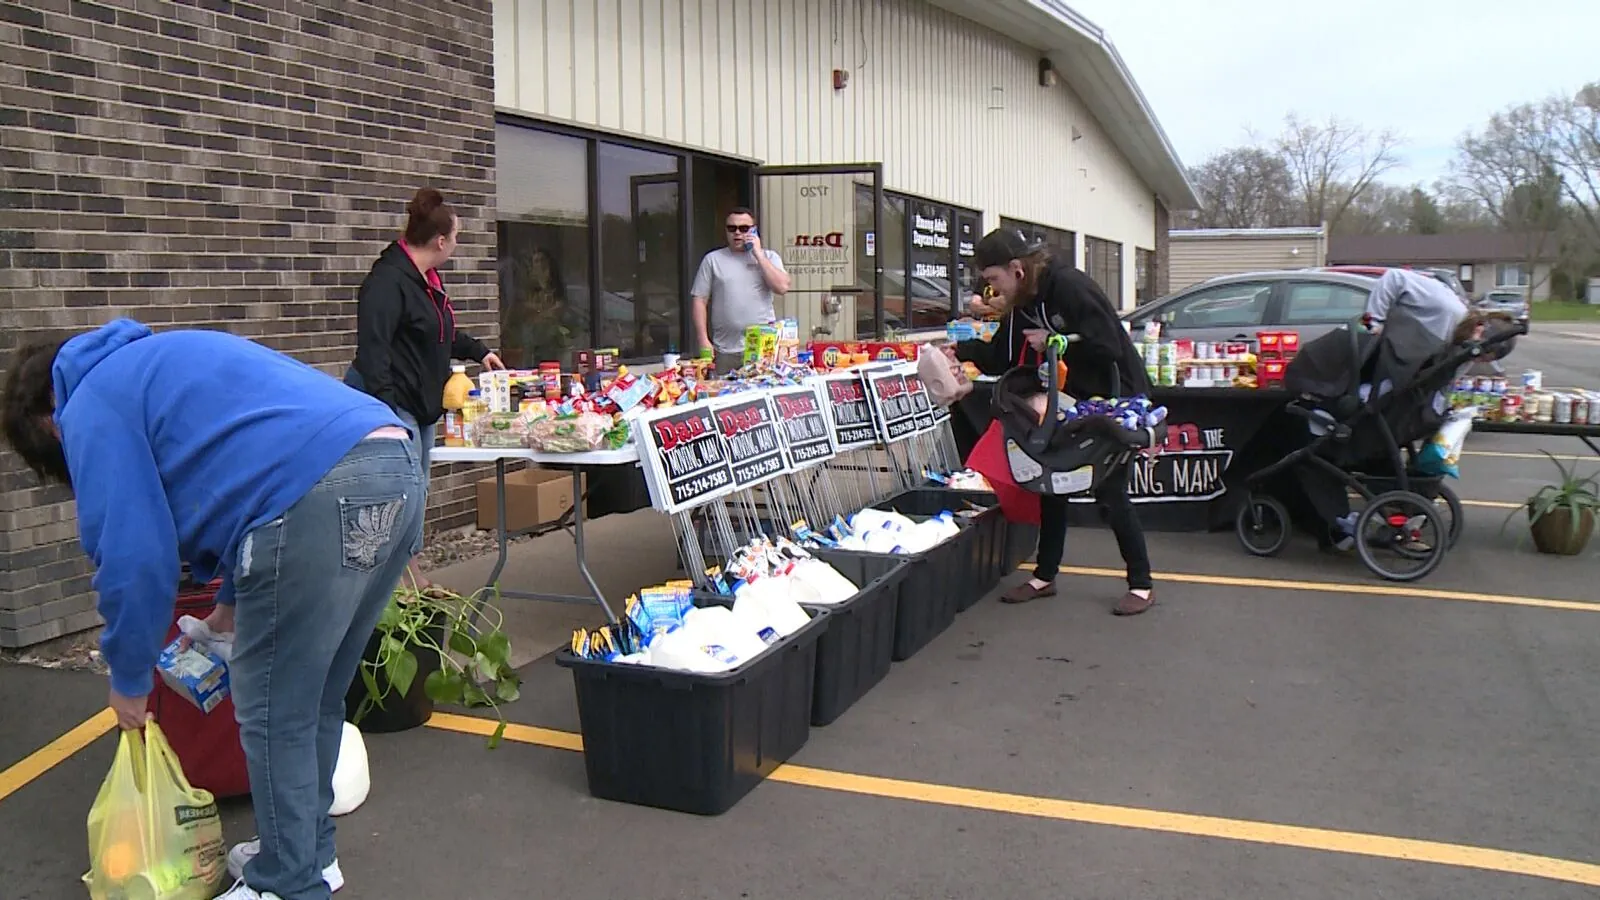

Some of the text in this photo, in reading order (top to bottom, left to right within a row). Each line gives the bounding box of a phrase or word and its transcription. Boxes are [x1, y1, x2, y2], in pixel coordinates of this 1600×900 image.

[719, 406, 760, 438] Dan
[780, 395, 811, 420] Dan
[655, 416, 704, 450] Dan
[730, 426, 778, 460] MOVING MAN
[1204, 428, 1225, 449] THE
[668, 436, 720, 476] MOVING MAN
[736, 457, 780, 482] 715-214-7583
[676, 470, 728, 500] 715-214-7583
[1173, 458, 1218, 494] MAN
